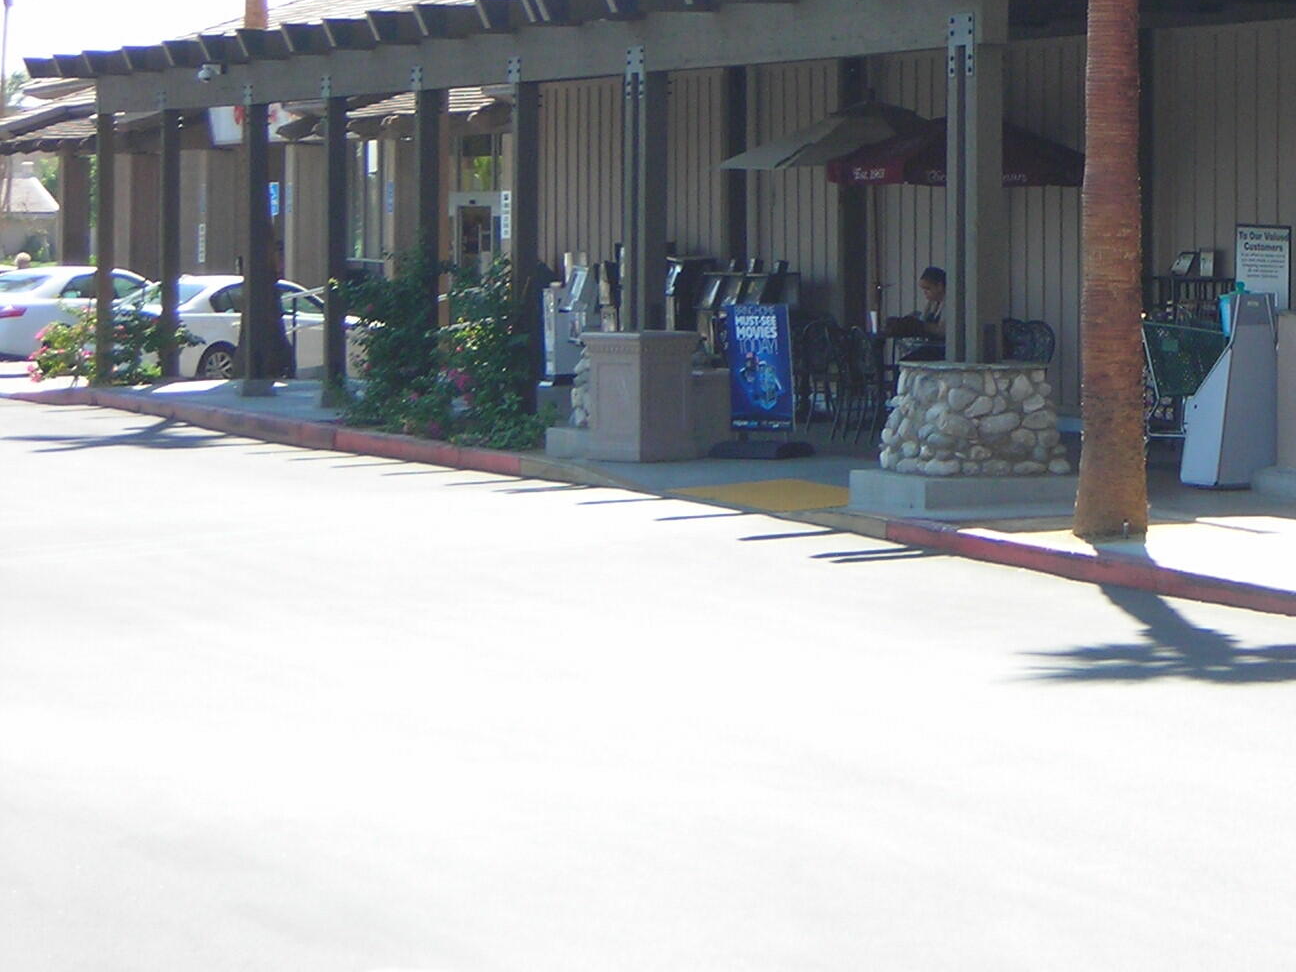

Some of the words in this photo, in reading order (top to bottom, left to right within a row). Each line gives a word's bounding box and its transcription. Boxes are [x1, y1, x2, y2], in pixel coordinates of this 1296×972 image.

[1239, 231, 1248, 240] To
[1250, 231, 1263, 240] Our
[1244, 242, 1283, 252] Customers
[735, 315, 777, 327] MUST-SEE
[736, 327, 778, 339] MOVIES
